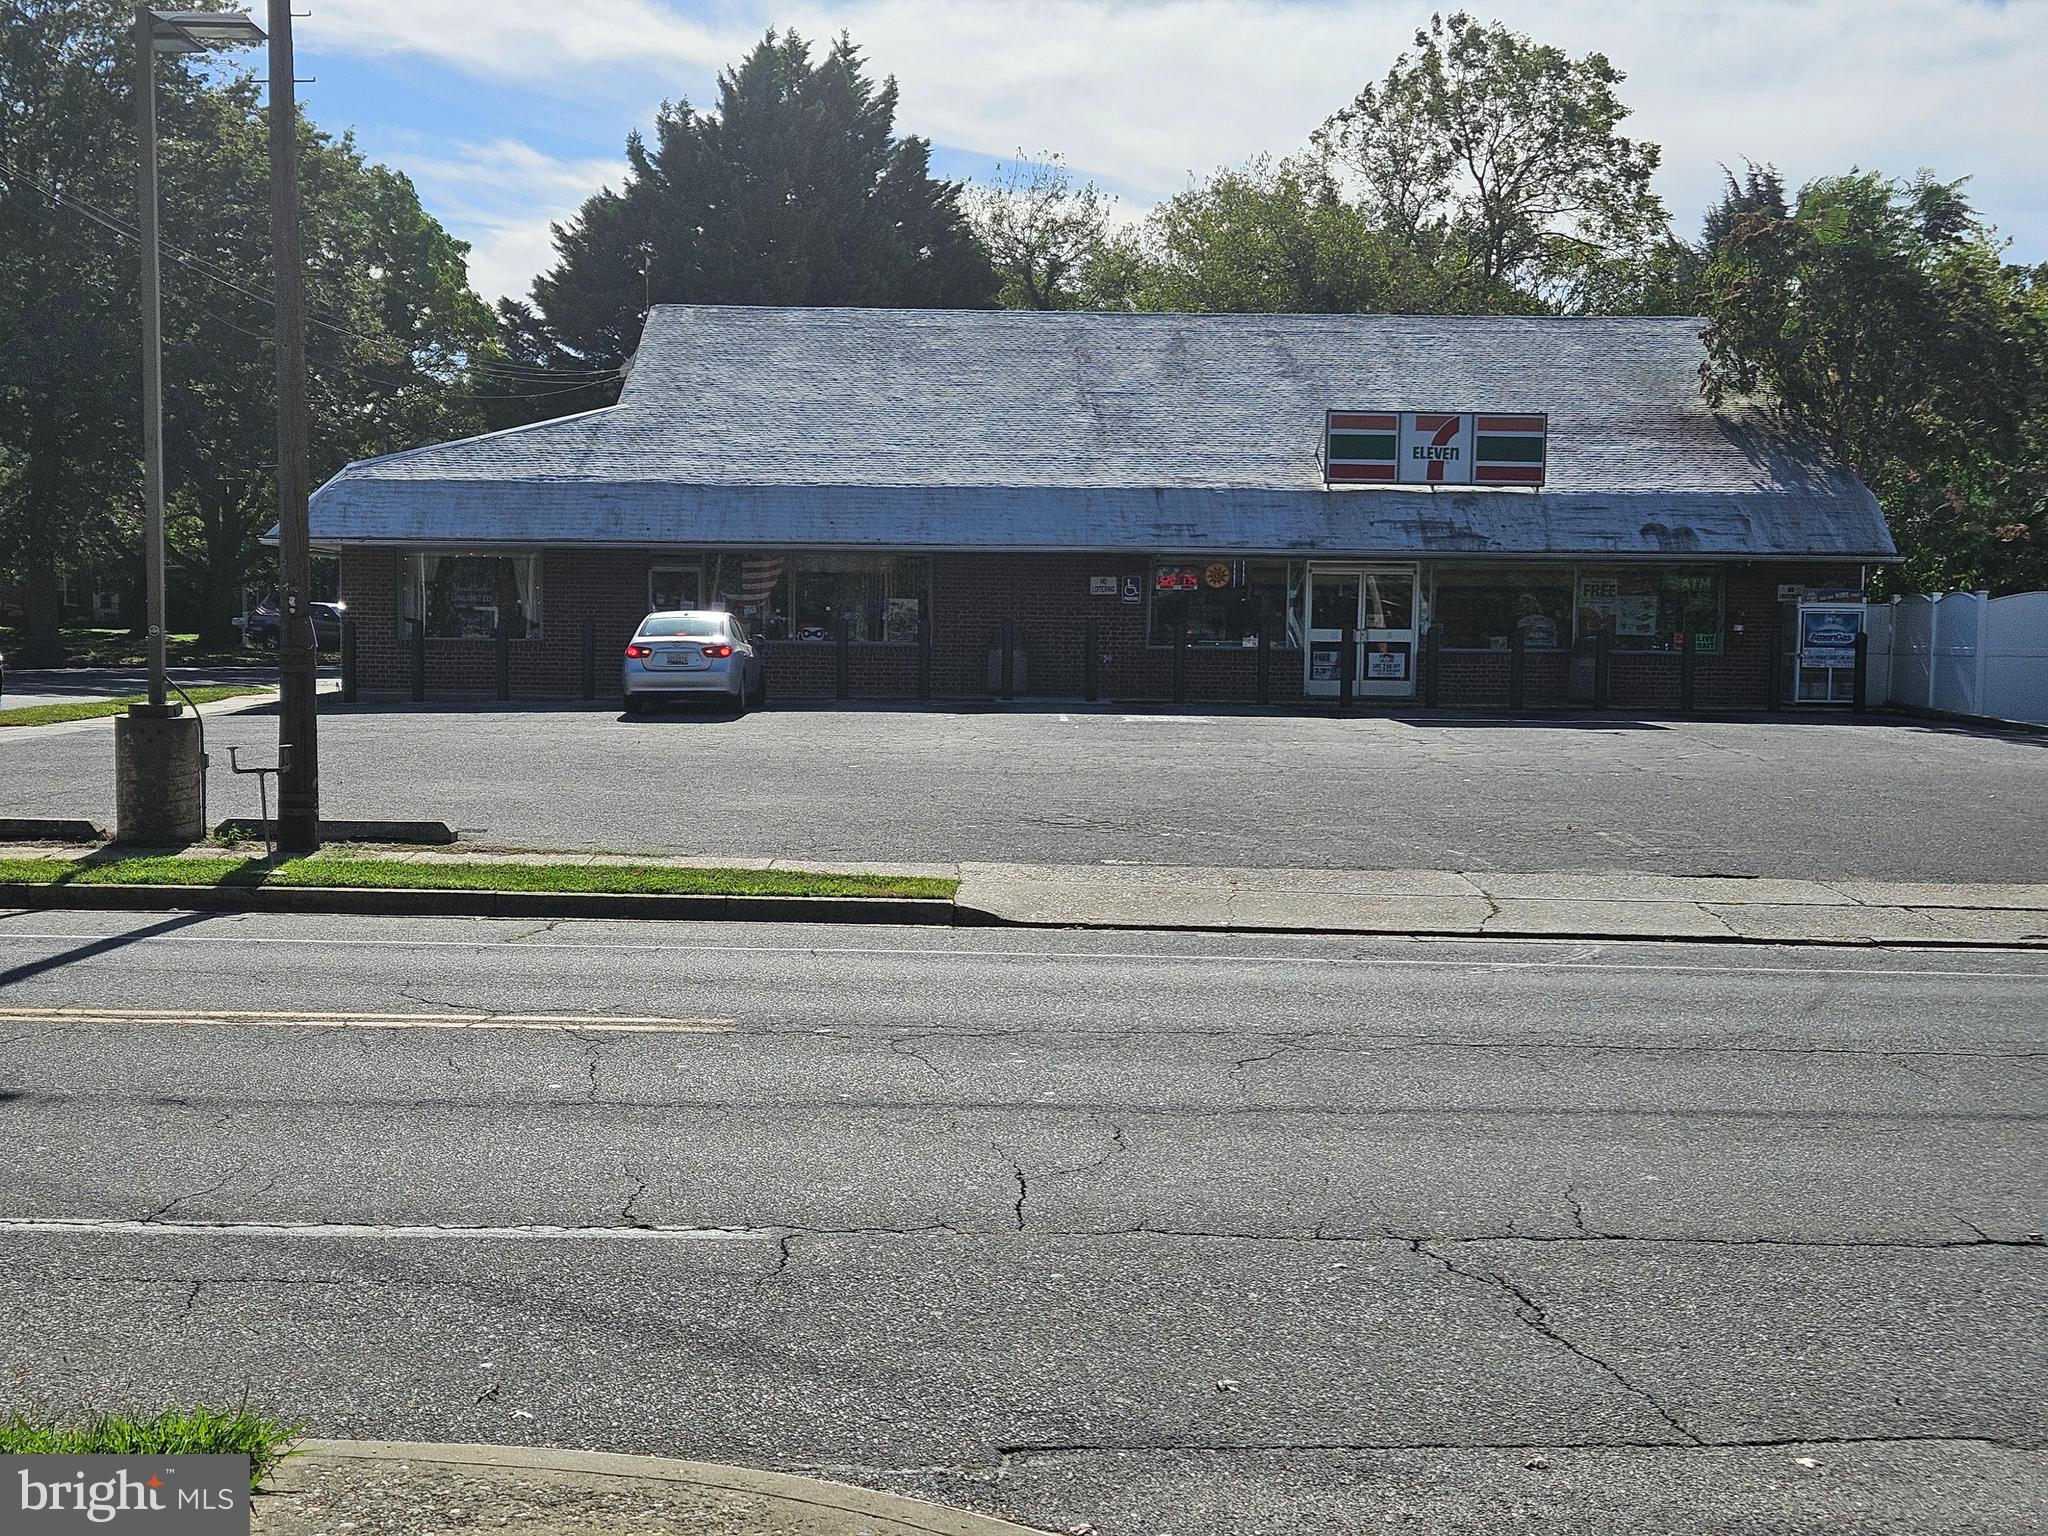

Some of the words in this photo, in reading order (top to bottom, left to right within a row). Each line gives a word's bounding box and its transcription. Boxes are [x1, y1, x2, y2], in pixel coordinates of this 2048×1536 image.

[1415, 415, 1460, 480] 7
[1681, 577, 1712, 588] ATM
[1584, 584, 1616, 597] FREE
[1810, 633, 1852, 641] AmeriGas
